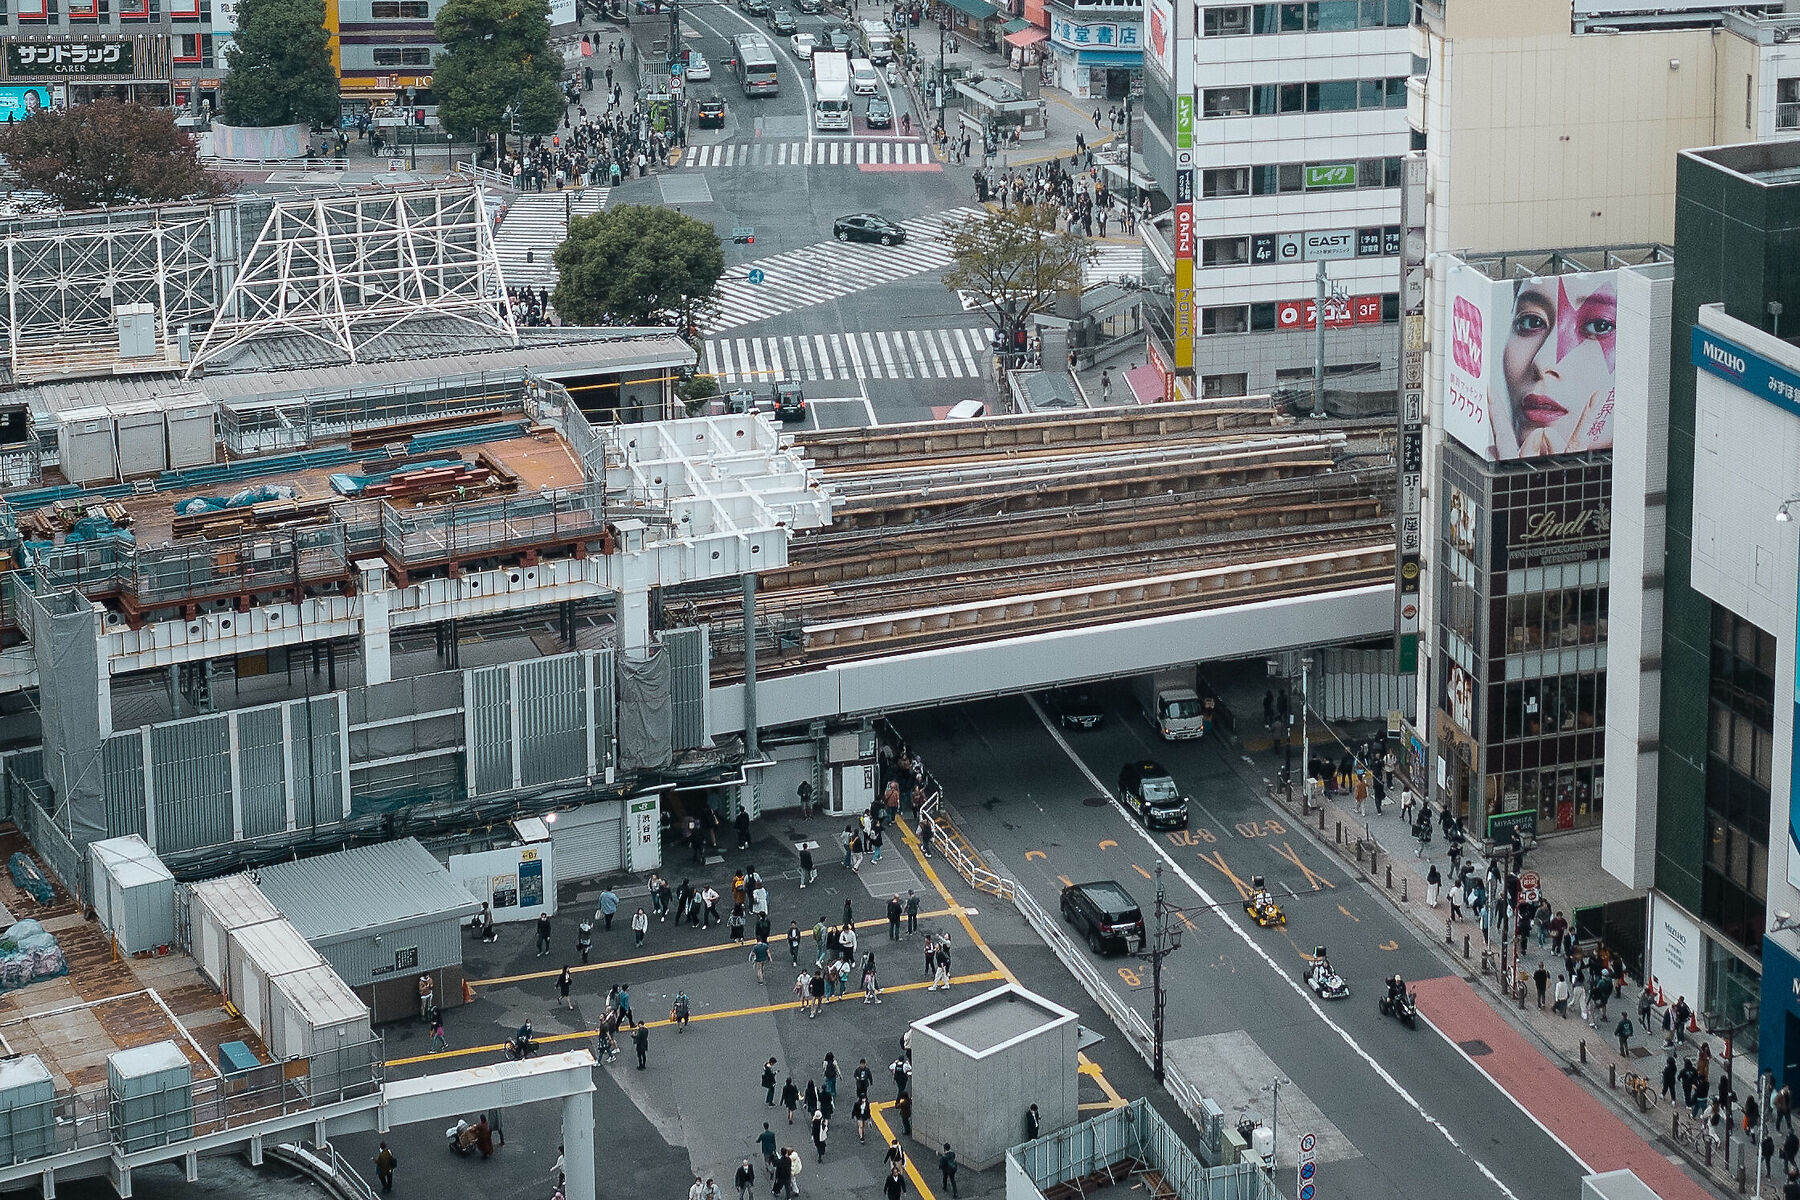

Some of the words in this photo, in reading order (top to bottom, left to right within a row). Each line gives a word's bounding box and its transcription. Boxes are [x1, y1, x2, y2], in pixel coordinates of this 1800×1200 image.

[1053, 20, 1137, 44] 大盛堂書店
[18, 45, 120, 64] サンドラッグ
[1180, 99, 1189, 127] レイク
[1312, 167, 1347, 182] レイク
[1179, 223, 1189, 251] アコム
[1308, 235, 1350, 247] EAST
[1257, 246, 1271, 259] 4F
[1179, 288, 1191, 337] プロミス
[1360, 304, 1377, 316] 3F
[1703, 340, 1746, 374] MIZUHO
[1404, 475, 1419, 487] 3F
[1520, 510, 1593, 540] Lindt
[1494, 815, 1533, 828] MIYASHITA
